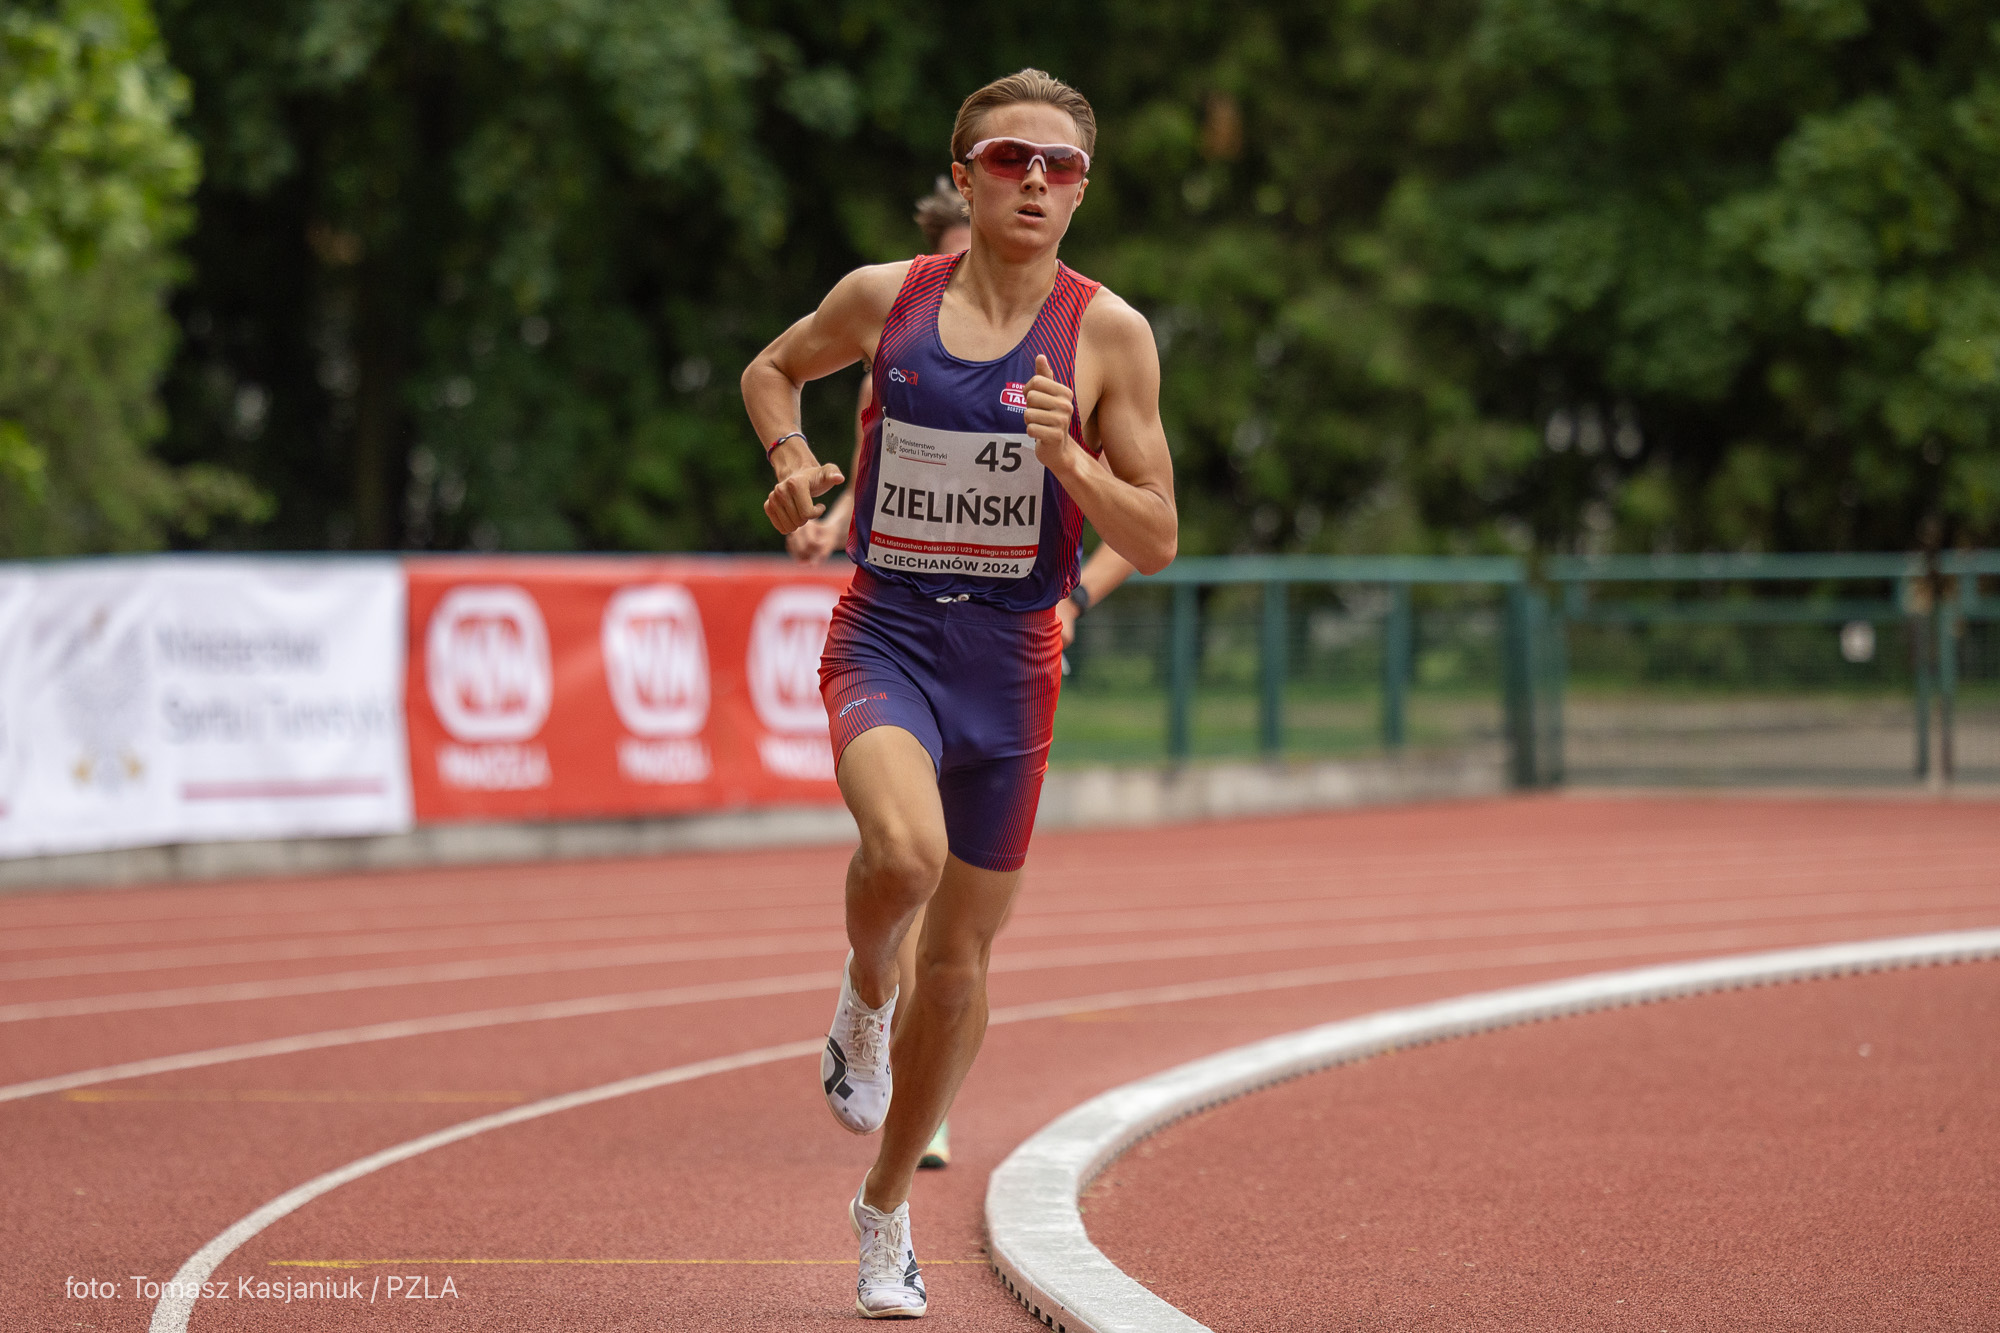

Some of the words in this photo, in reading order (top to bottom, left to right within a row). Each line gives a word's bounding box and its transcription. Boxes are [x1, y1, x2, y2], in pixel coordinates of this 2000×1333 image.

[898, 445, 917, 456] Sportu
[920, 449, 948, 460] Turystyki
[899, 438, 935, 451] Ministerstwo
[974, 441, 1022, 473] 45
[880, 481, 1036, 527] ZIELIŃSKI
[874, 536, 886, 545] PZLA
[886, 539, 923, 551] Mistrzostwa
[923, 544, 942, 552] Polski
[980, 548, 999, 557] Biegu
[883, 554, 979, 572] CIECHANÓW
[982, 562, 1020, 574] 2024
